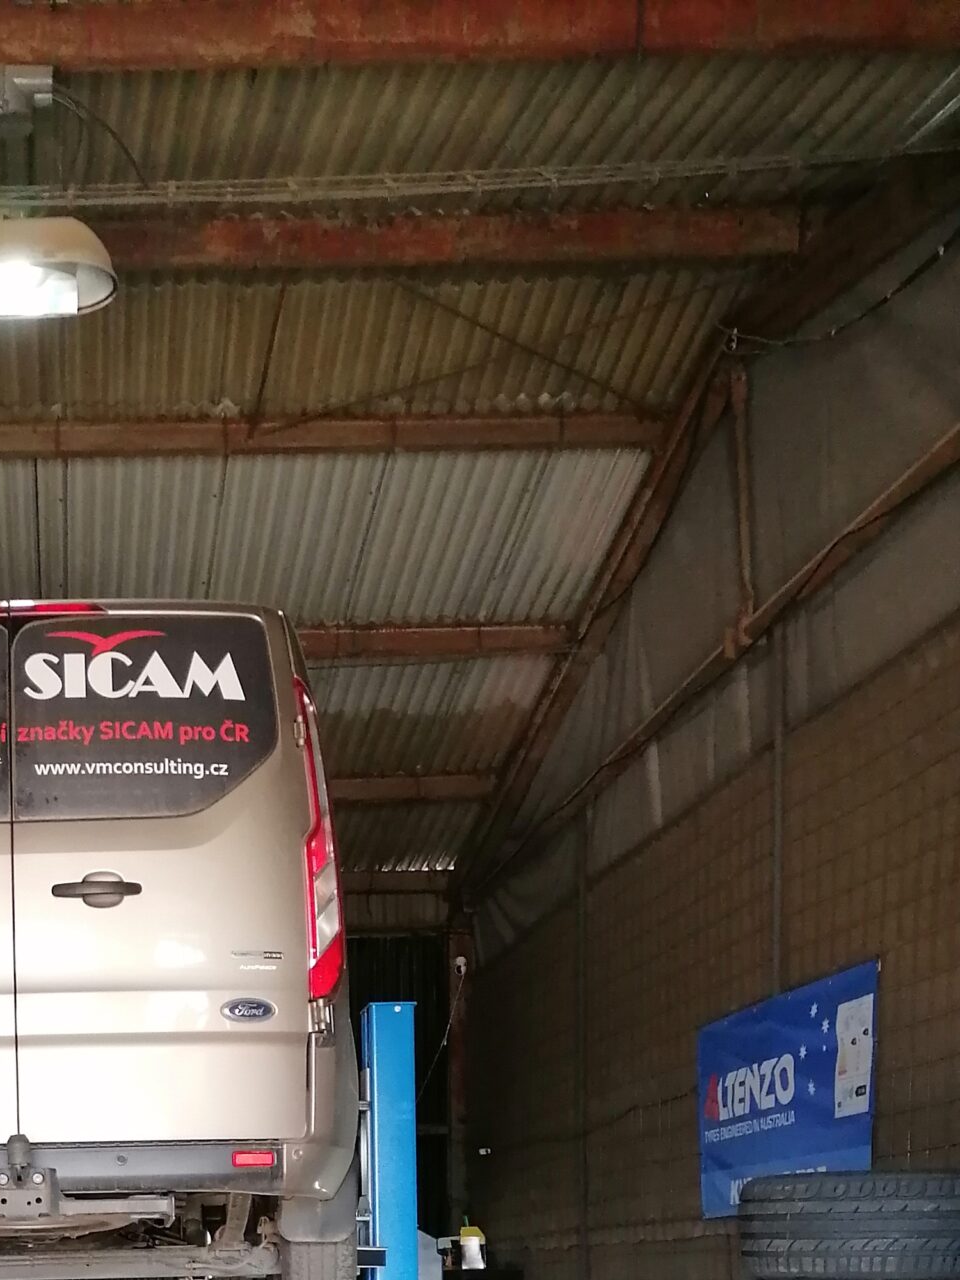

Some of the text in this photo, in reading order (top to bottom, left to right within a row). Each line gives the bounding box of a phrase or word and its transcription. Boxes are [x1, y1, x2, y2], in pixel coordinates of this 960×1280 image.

[23, 650, 246, 701] SICAM
[17, 719, 95, 745] značky
[100, 721, 173, 740] SICAM
[180, 724, 215, 745] pro
[220, 719, 250, 743] ČR
[34, 758, 229, 779] www.vmconsulting.cz
[234, 1003, 265, 1016] Ford
